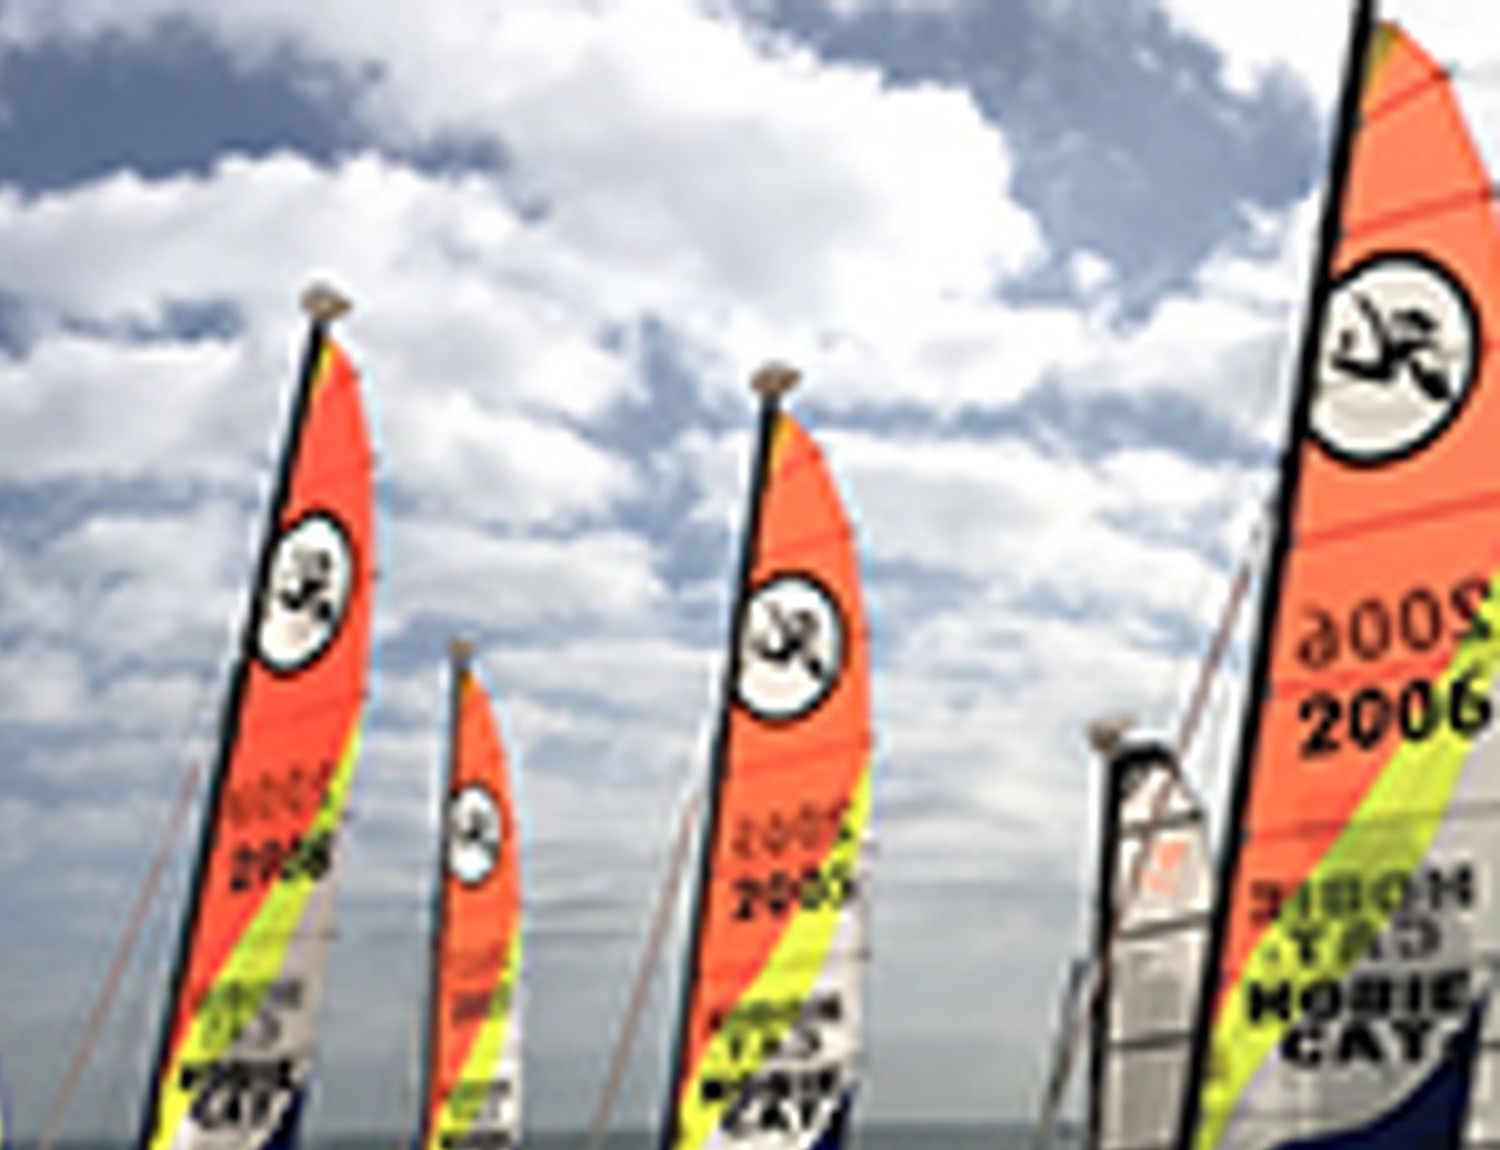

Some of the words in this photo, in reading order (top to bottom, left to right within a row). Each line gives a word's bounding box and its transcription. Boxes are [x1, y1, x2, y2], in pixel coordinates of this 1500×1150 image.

[1298, 659, 1492, 762] 2006
[1247, 967, 1472, 1027] HOBIE
[1281, 1018, 1432, 1069] CAT
